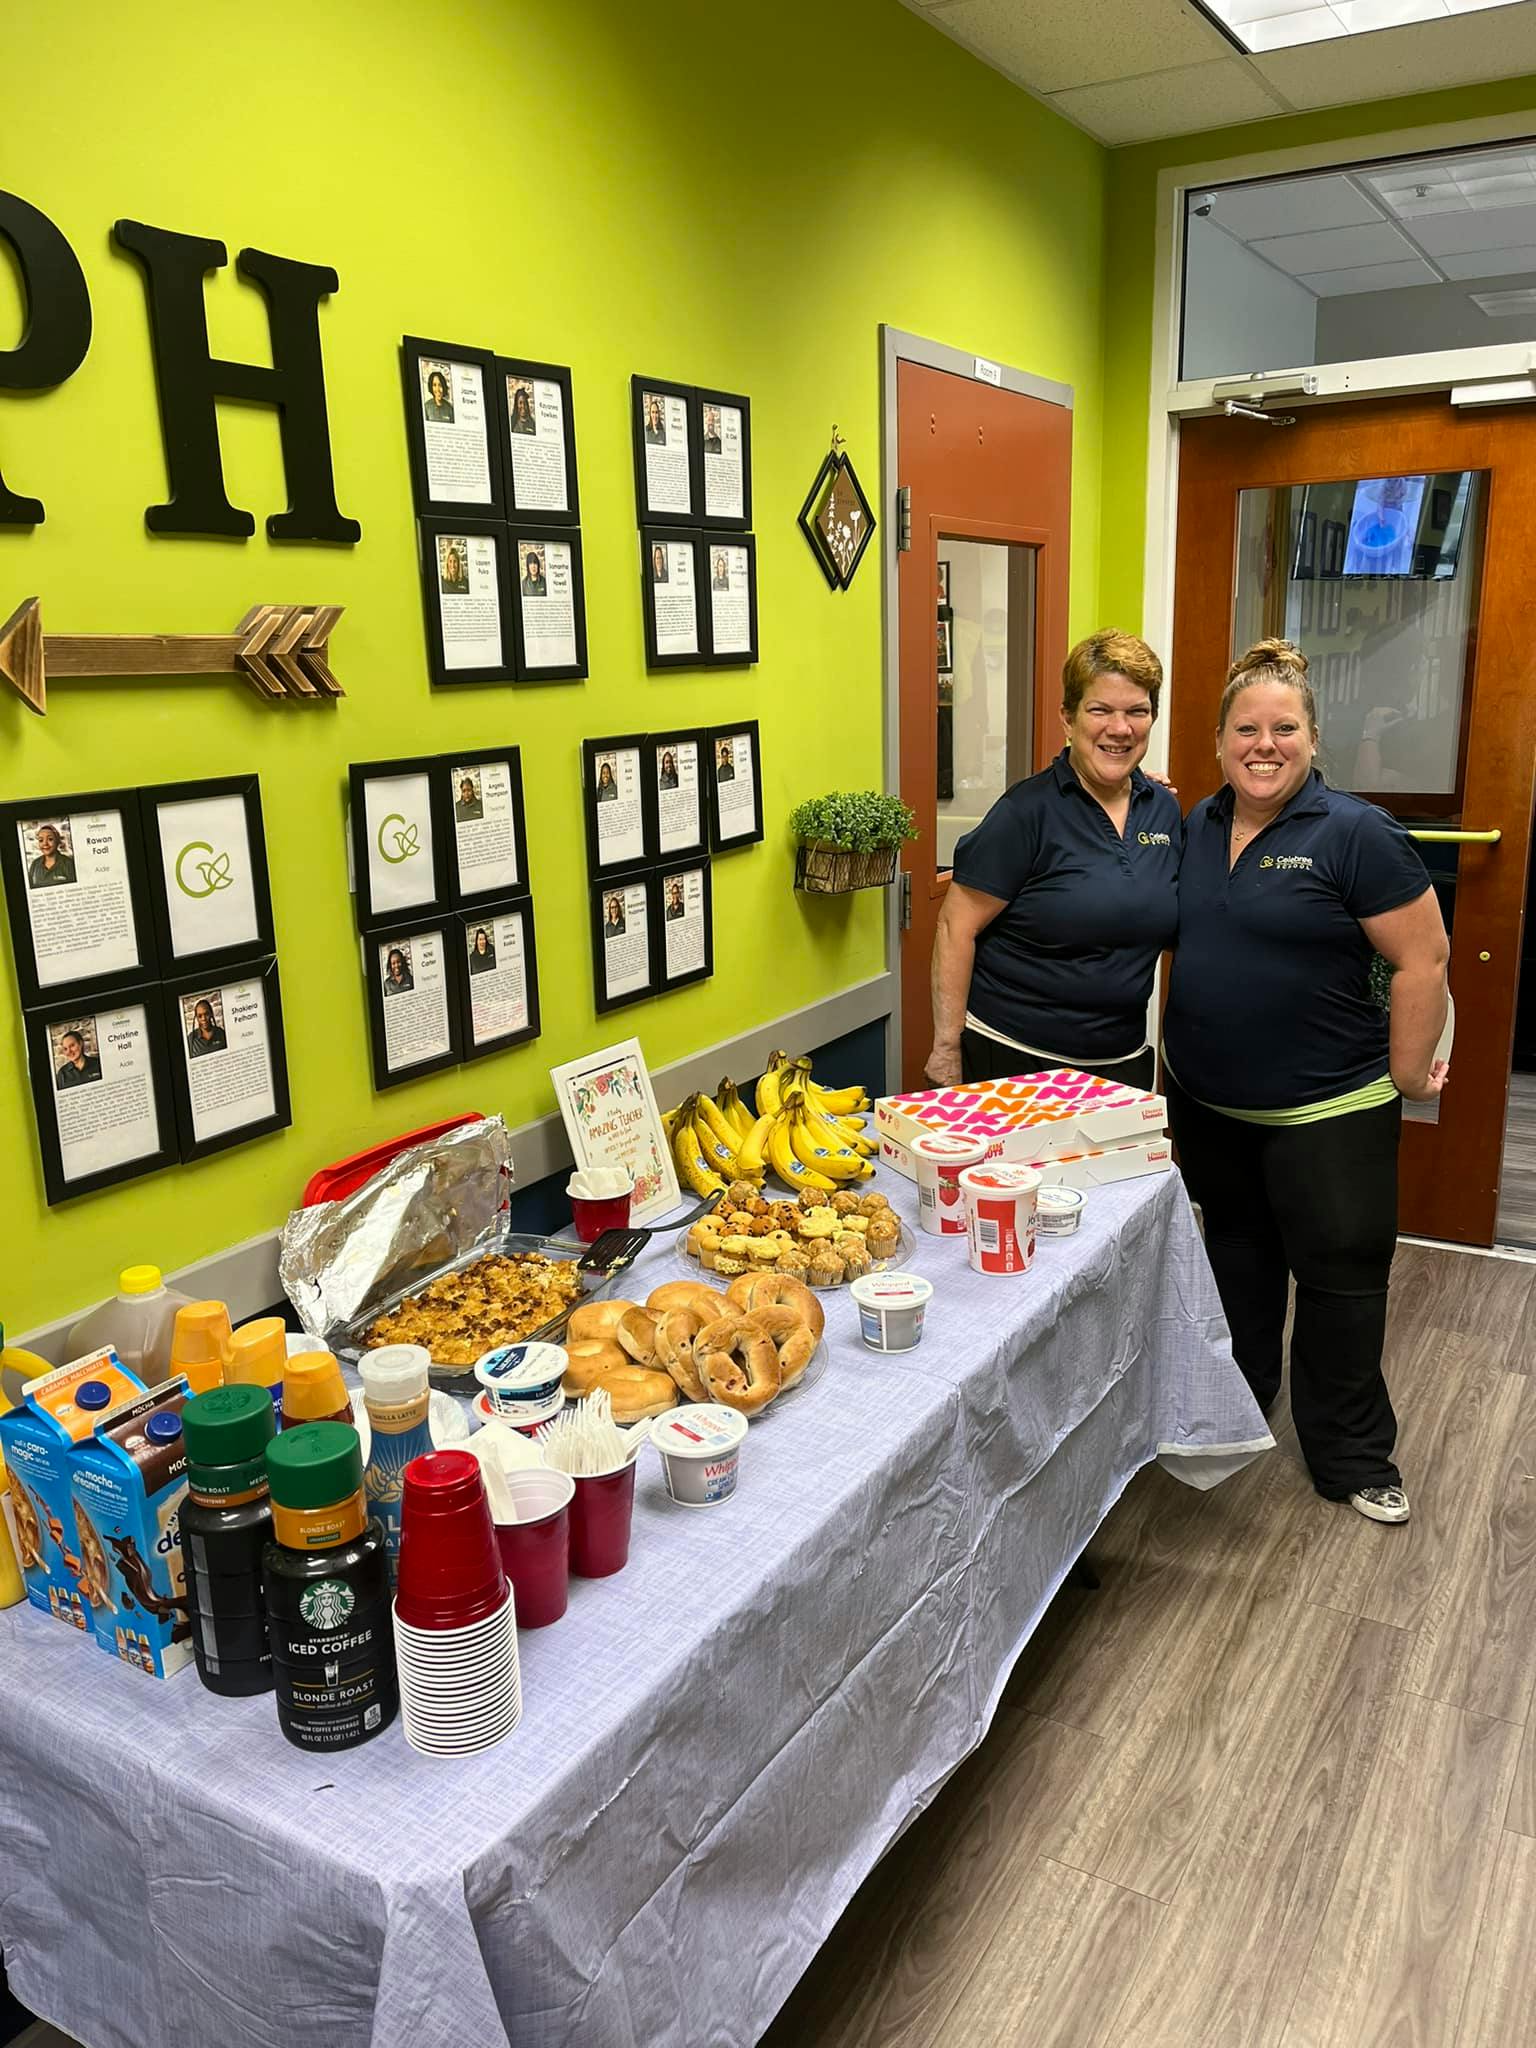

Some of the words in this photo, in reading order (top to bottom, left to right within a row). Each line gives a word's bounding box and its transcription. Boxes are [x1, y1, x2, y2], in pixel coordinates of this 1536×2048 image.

[86, 836, 113, 845] Rawan
[107, 1030, 139, 1043] Christine
[117, 1041, 132, 1051] Hall
[588, 1118, 618, 1140] AMAZING
[618, 1108, 644, 1127] TEACHER
[40, 1376, 69, 1396] CARAMEL
[70, 1360, 105, 1381] MACCHIATO
[131, 1400, 155, 1417] MOCHA
[397, 1409, 417, 1420] LATTE
[11, 1445, 34, 1461] magic
[168, 1456, 188, 1475] MOC
[72, 1473, 100, 1493] dreams
[85, 1470, 113, 1489] mocha
[208, 1486, 230, 1494] ROAST
[299, 1524, 326, 1534] BLONDE
[326, 1520, 346, 1531] ROAST
[288, 1642, 318, 1655] ICED
[321, 1629, 373, 1655] COFFEE
[309, 1632, 348, 1644] STARBUCKS
[292, 1690, 335, 1702] BLONDE
[340, 1678, 375, 1700] ROAST
[332, 1719, 360, 1732] BEVERAGE
